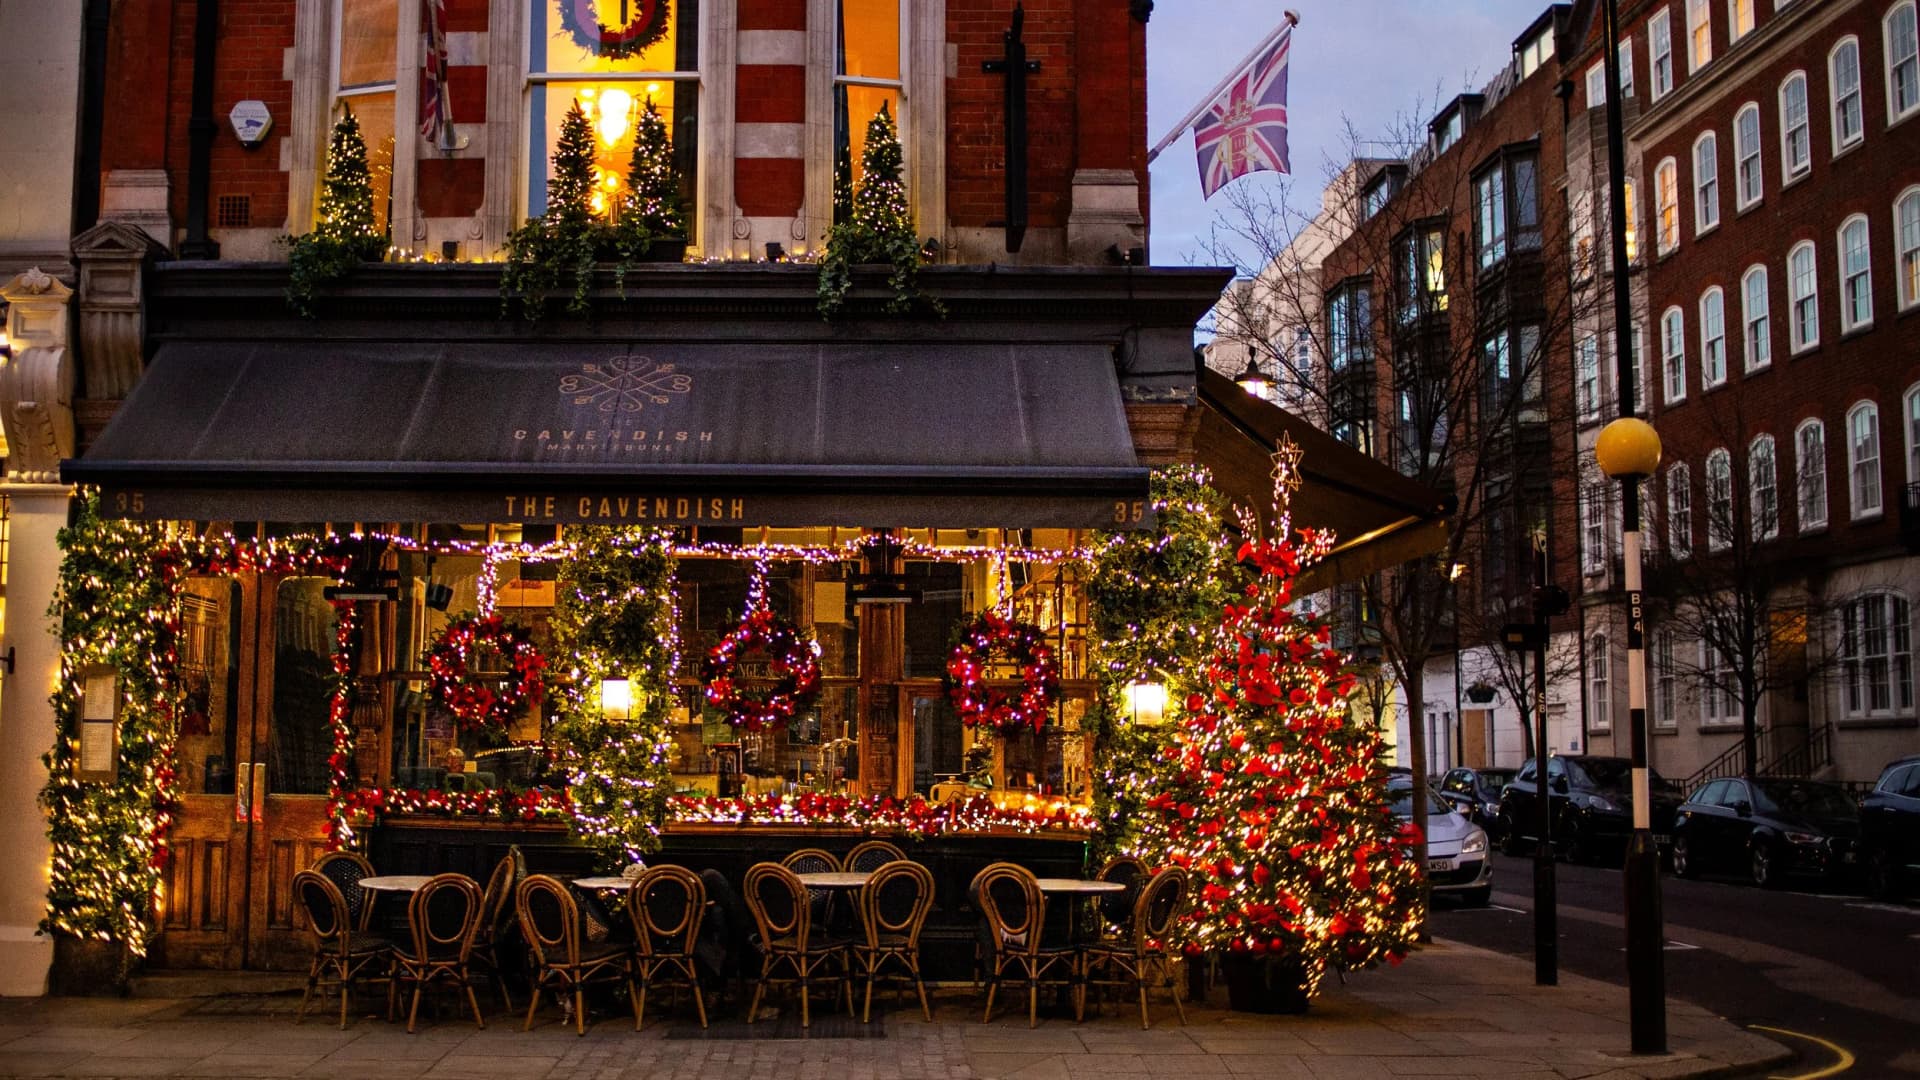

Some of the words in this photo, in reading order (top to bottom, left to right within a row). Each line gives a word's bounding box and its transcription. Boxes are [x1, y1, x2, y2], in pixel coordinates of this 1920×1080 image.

[513, 429, 714, 442] CAVENDISH
[115, 492, 145, 513] 35
[505, 496, 556, 518] THE
[578, 497, 745, 519] CAVENDISH
[1113, 501, 1144, 523] 35
[1631, 592, 1642, 633] BB4
